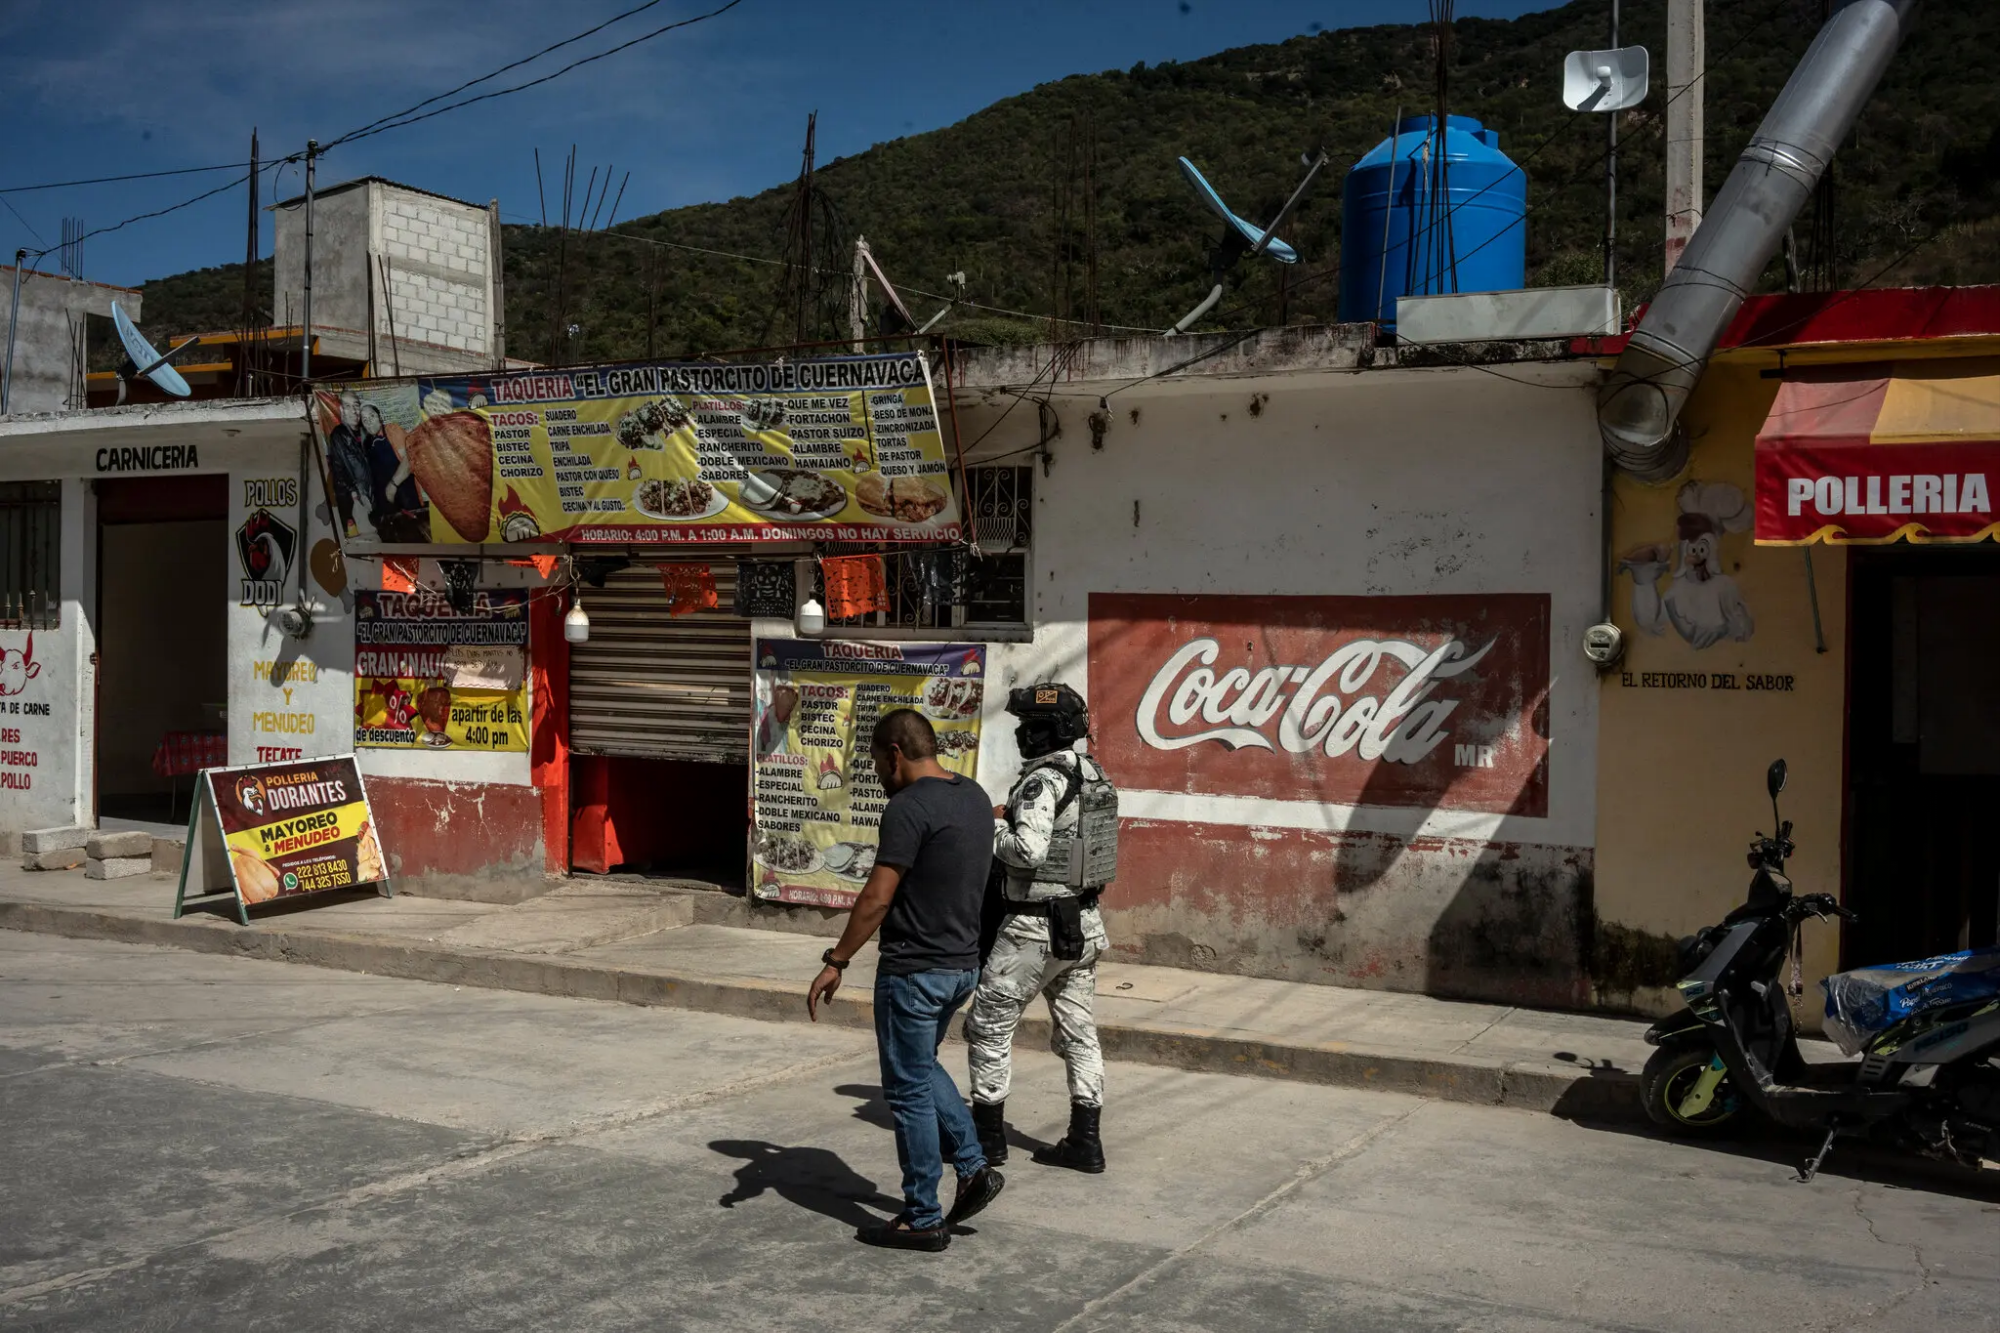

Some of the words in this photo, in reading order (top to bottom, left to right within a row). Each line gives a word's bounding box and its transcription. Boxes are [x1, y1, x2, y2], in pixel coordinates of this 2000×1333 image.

[491, 375, 575, 402] TAQUERIA
[608, 367, 656, 395] GRAN
[660, 365, 766, 392] PASTORCITO
[770, 363, 796, 391] DE
[799, 358, 926, 391] CUERNAVACA
[692, 401, 745, 411] PLATILLOS:
[785, 399, 809, 409] -QUE
[811, 399, 826, 409] ME
[829, 398, 849, 408] VEZ
[870, 395, 903, 405] -GRINGA
[490, 412, 539, 426] TACOS:
[545, 410, 577, 421] SUADERO
[694, 415, 741, 424] -ALAMBRE
[786, 413, 850, 424] -FORTACHON
[896, 408, 908, 418] DE
[495, 429, 531, 439] PASTOR
[548, 426, 571, 437] CARNE
[572, 423, 611, 435] ENCHILADA
[695, 429, 745, 438] -ESPECIAL
[789, 429, 830, 439] -PASTOR
[832, 427, 865, 438] SUIZO
[496, 442, 530, 452] BISTEC
[550, 441, 571, 452] TRIPA
[696, 442, 763, 452] -RANCHERITO
[876, 437, 907, 447] TORTAS
[790, 444, 841, 454] -ALAMBRE
[879, 451, 890, 461] DE
[891, 450, 922, 461] PASTOR
[96, 445, 199, 472] CARNICERIA
[498, 455, 534, 465] CECINA
[553, 456, 592, 467] ENCHILADA
[697, 456, 734, 467] -DOBLE
[738, 456, 789, 467] MEXICANO
[795, 458, 851, 468] HAWAIANO
[500, 468, 543, 477] CHORIZO
[881, 465, 907, 476] QUESO
[909, 465, 915, 474] Y
[917, 461, 946, 474] JAMÓN
[556, 471, 582, 482] PASTOR
[584, 470, 598, 480] CON
[598, 469, 619, 480] QUESO
[244, 479, 298, 507] POLLOS
[559, 487, 584, 497] BISTEC
[1787, 473, 1991, 516] POLLERIA
[562, 502, 587, 512] CECINA
[588, 501, 593, 510] Y
[593, 501, 601, 511] AL
[582, 529, 633, 541] HORARIO:
[635, 529, 658, 541] 4:00
[662, 529, 685, 541] P.M.
[688, 529, 696, 541] A
[700, 529, 727, 541] 1:00
[730, 528, 758, 540] A.M.
[762, 528, 835, 540] DOMINGOS
[838, 528, 857, 540] NO
[861, 528, 889, 539] HAY
[893, 528, 960, 540] SERVICIO
[240, 579, 284, 606] DODI
[372, 623, 397, 643] GRAN
[397, 623, 449, 643] PASTORCITO
[450, 623, 463, 643] DE
[822, 643, 903, 660] TAQUERIA
[253, 660, 317, 682] MAYOREO
[357, 652, 399, 677] GRAN
[801, 661, 823, 671] GRAN
[824, 661, 875, 674] PASTORCITO
[876, 664, 888, 674] DE
[856, 684, 891, 692] SUADERO
[1622, 672, 1638, 688] EL
[1641, 672, 1707, 689] RETORNO
[1710, 673, 1741, 690] DEL
[1746, 674, 1794, 691] SABOR
[282, 688, 293, 705] Y
[801, 686, 849, 699] TACOS:
[856, 694, 881, 702] CARNE
[883, 696, 924, 704] ENCHILADA
[801, 700, 838, 710] PASTOR
[1136, 635, 1497, 765] Coca-Cola
[1454, 744, 1494, 768] MR
[10, 702, 19, 714] DE
[23, 703, 50, 716] CARNE
[491, 706, 504, 722] de
[507, 705, 523, 723] las
[253, 712, 315, 734] MENUDEO
[801, 713, 835, 723] BISTEC
[1, 728, 21, 743] RES
[356, 727, 367, 741] de
[369, 727, 415, 743] descuento
[801, 725, 836, 735] CECINA
[465, 727, 489, 744] 4:00
[492, 730, 509, 748] pm
[801, 738, 844, 748] CHORIZO
[1, 751, 38, 767] PUERCO
[757, 754, 808, 766] PLATILLOS:
[1, 772, 31, 790] POLLO
[266, 771, 319, 787] POLLERIA
[267, 780, 348, 811] DORANTES
[791, 810, 840, 822] MEXICANO
[260, 812, 338, 843] MAYOREO
[265, 845, 271, 853] &
[274, 825, 341, 855] MENUDEO
[296, 866, 313, 879] 222
[314, 863, 327, 876] 813
[328, 859, 348, 873] 8430
[299, 878, 316, 892] 744
[317, 876, 332, 889] 325
[332, 871, 351, 887] 7550
